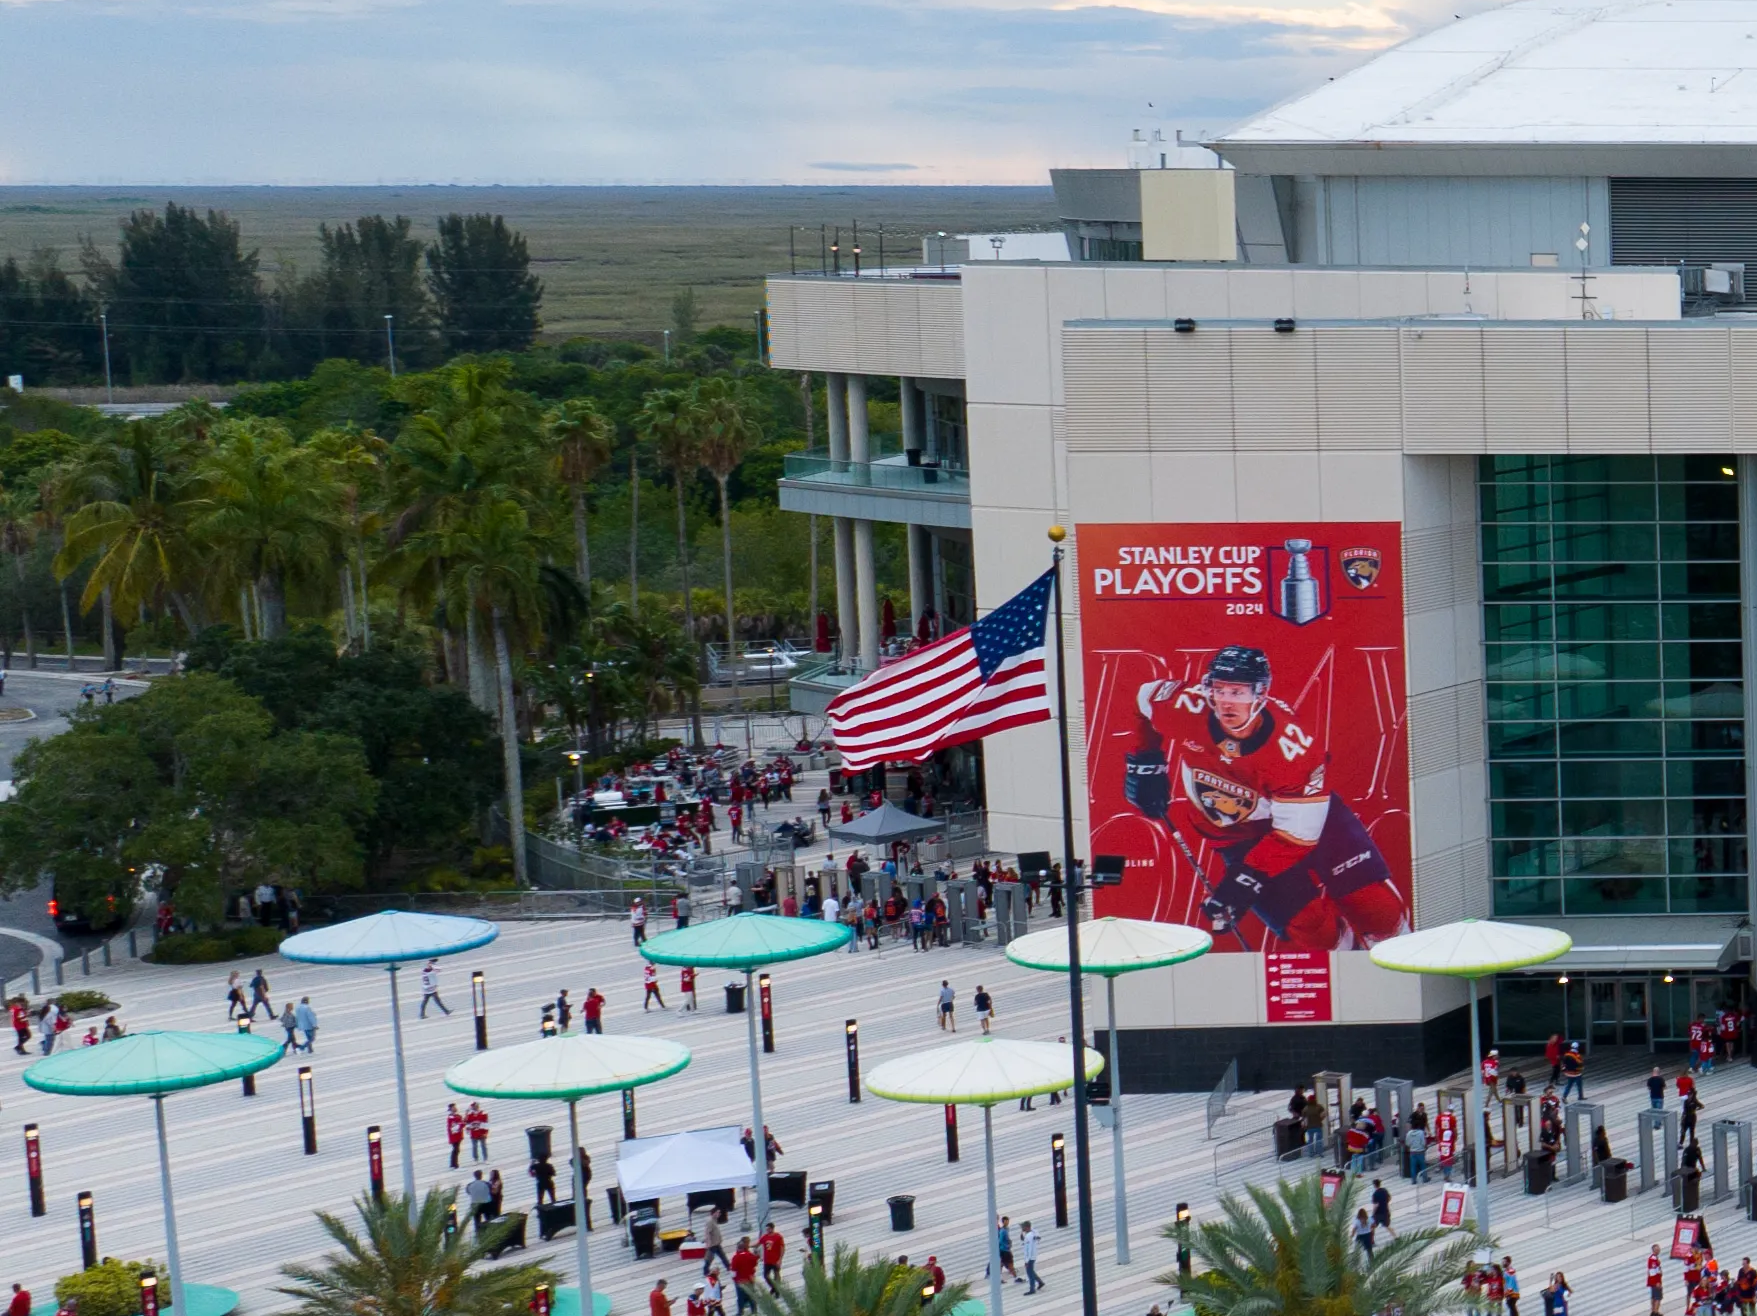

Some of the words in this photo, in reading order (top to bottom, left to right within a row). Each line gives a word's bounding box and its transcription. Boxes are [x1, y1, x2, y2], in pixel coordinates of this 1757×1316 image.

[1118, 546, 1214, 564] STANLEY
[1218, 546, 1260, 564] CUP
[1094, 566, 1262, 595] PLAYOFFS
[1226, 603, 1263, 615] 2024
[1278, 723, 1314, 762] 42
[1196, 772, 1252, 799] PANTHERS
